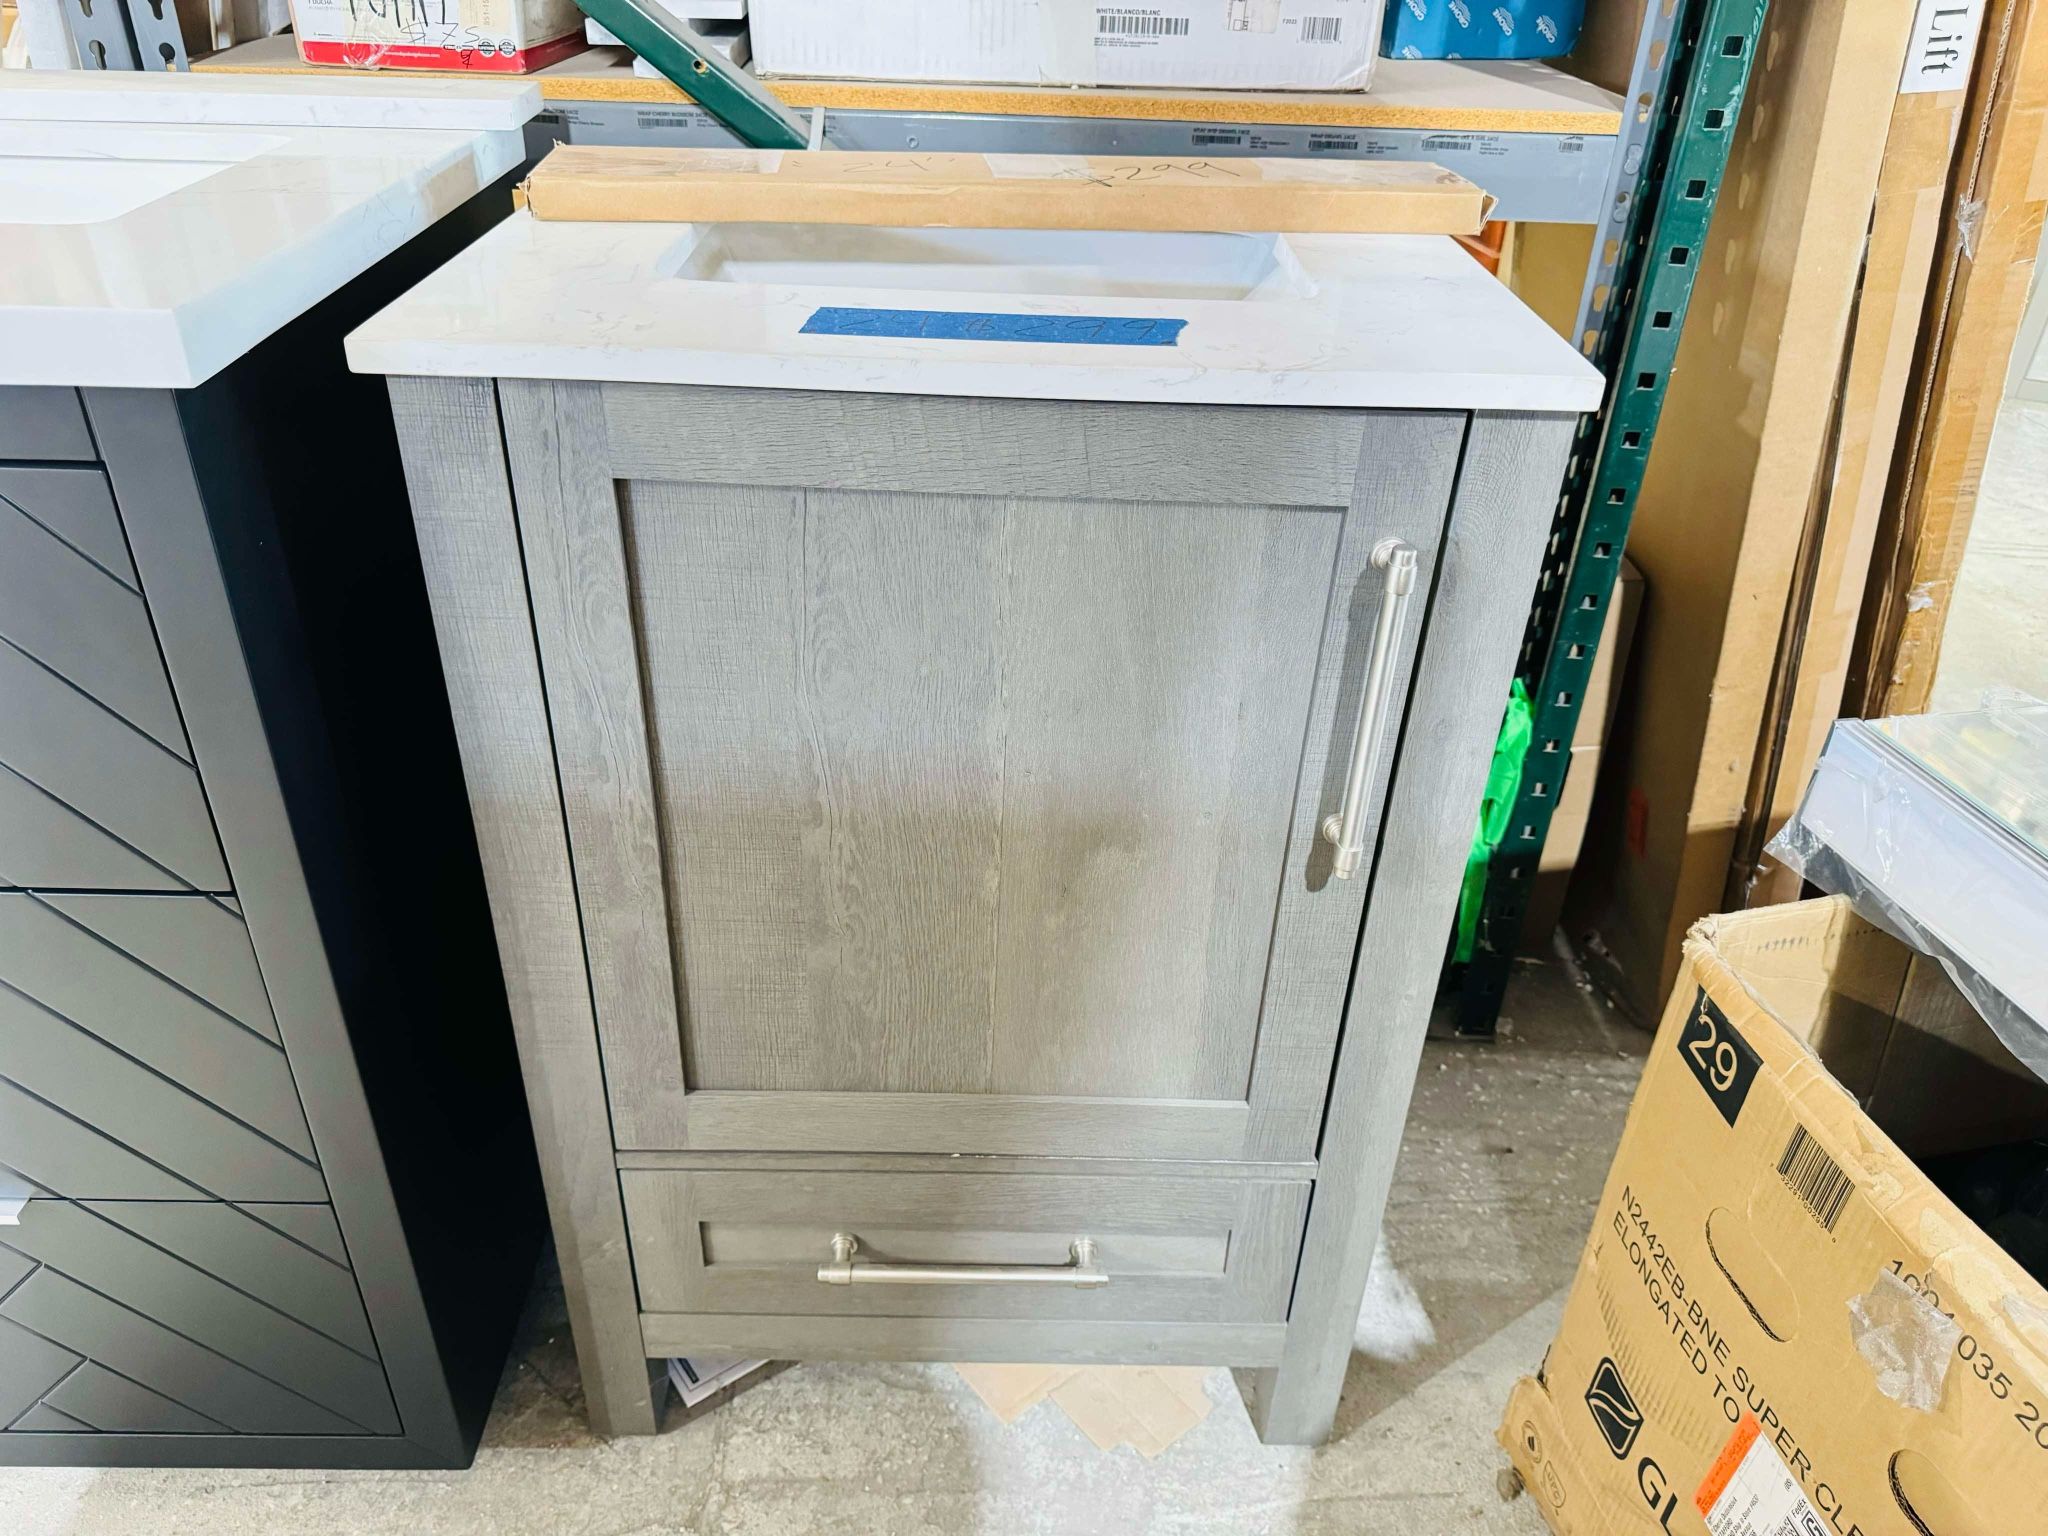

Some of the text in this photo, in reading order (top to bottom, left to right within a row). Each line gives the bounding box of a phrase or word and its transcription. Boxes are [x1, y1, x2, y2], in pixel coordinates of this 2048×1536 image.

[1096, 8, 1161, 16] WHITE/BLANCO/BLANC
[1448, 0, 1469, 29] GROHE
[1492, 8, 1512, 36] GROHE
[1535, 15, 1556, 44] GROHE
[1921, 4, 1970, 75] Lift
[1688, 1014, 1737, 1092] 29
[1613, 1210, 1708, 1375] ELONGATED
[1712, 1374, 1740, 1423] TO
[1621, 1185, 1730, 1368] N2442EB-BNE
[1732, 1366, 1812, 1482] SUPER
[1957, 1335, 2013, 1400] 035
[1791, 1498, 1807, 1519] FedEx
